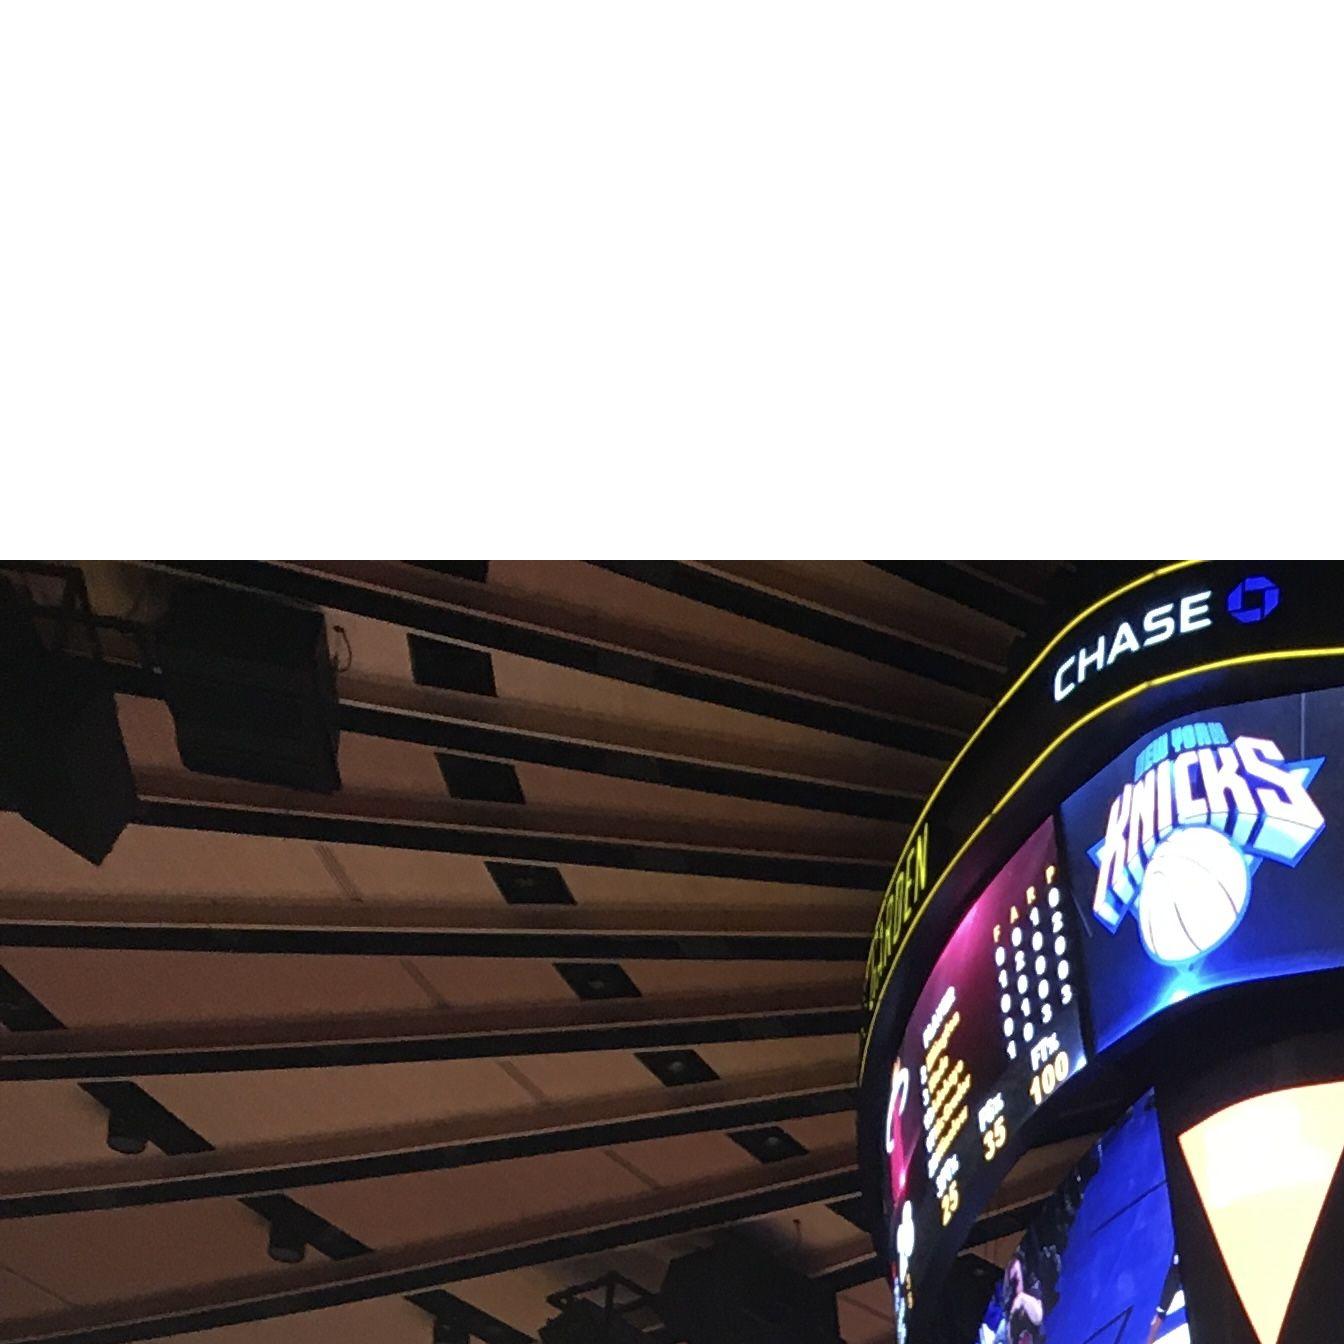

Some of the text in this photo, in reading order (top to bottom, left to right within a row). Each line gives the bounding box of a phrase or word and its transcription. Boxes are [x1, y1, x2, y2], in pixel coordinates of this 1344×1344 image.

[1054, 590, 1212, 703] CHASE
[1093, 735, 1325, 925] KNICKS
[1029, 1051, 1069, 1105] 100
[983, 1115, 1006, 1161] 35
